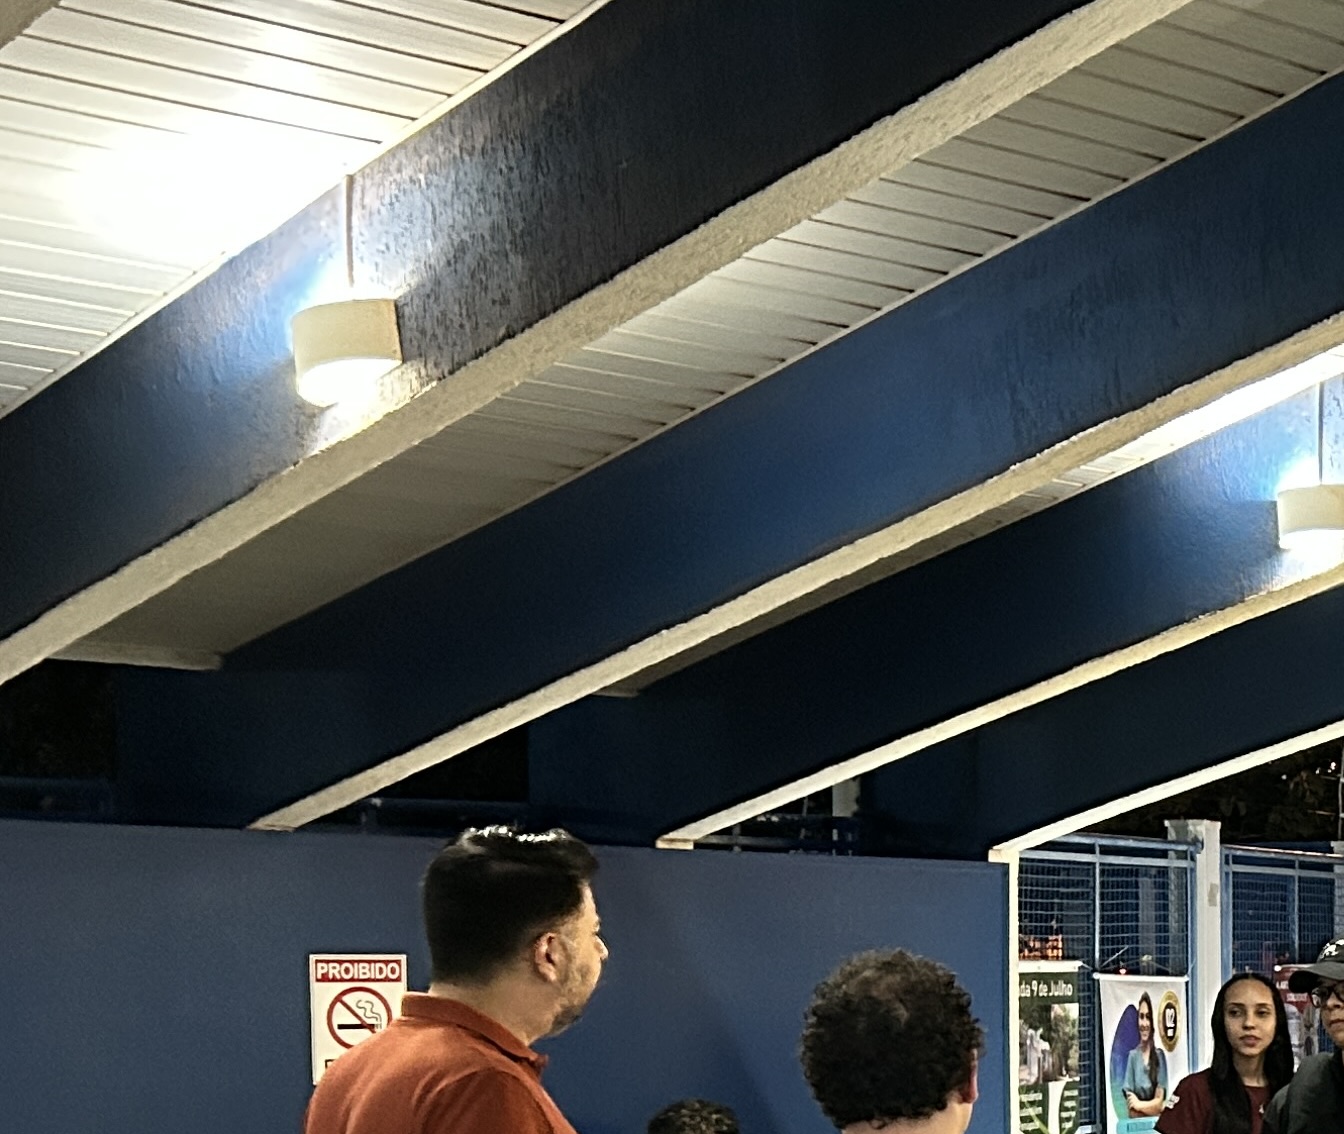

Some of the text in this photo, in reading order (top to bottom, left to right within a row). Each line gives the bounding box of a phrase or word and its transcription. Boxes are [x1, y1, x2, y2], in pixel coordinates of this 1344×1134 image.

[316, 962, 400, 980] PROIBIDO
[1031, 980, 1038, 997] 9
[1038, 980, 1048, 997] de
